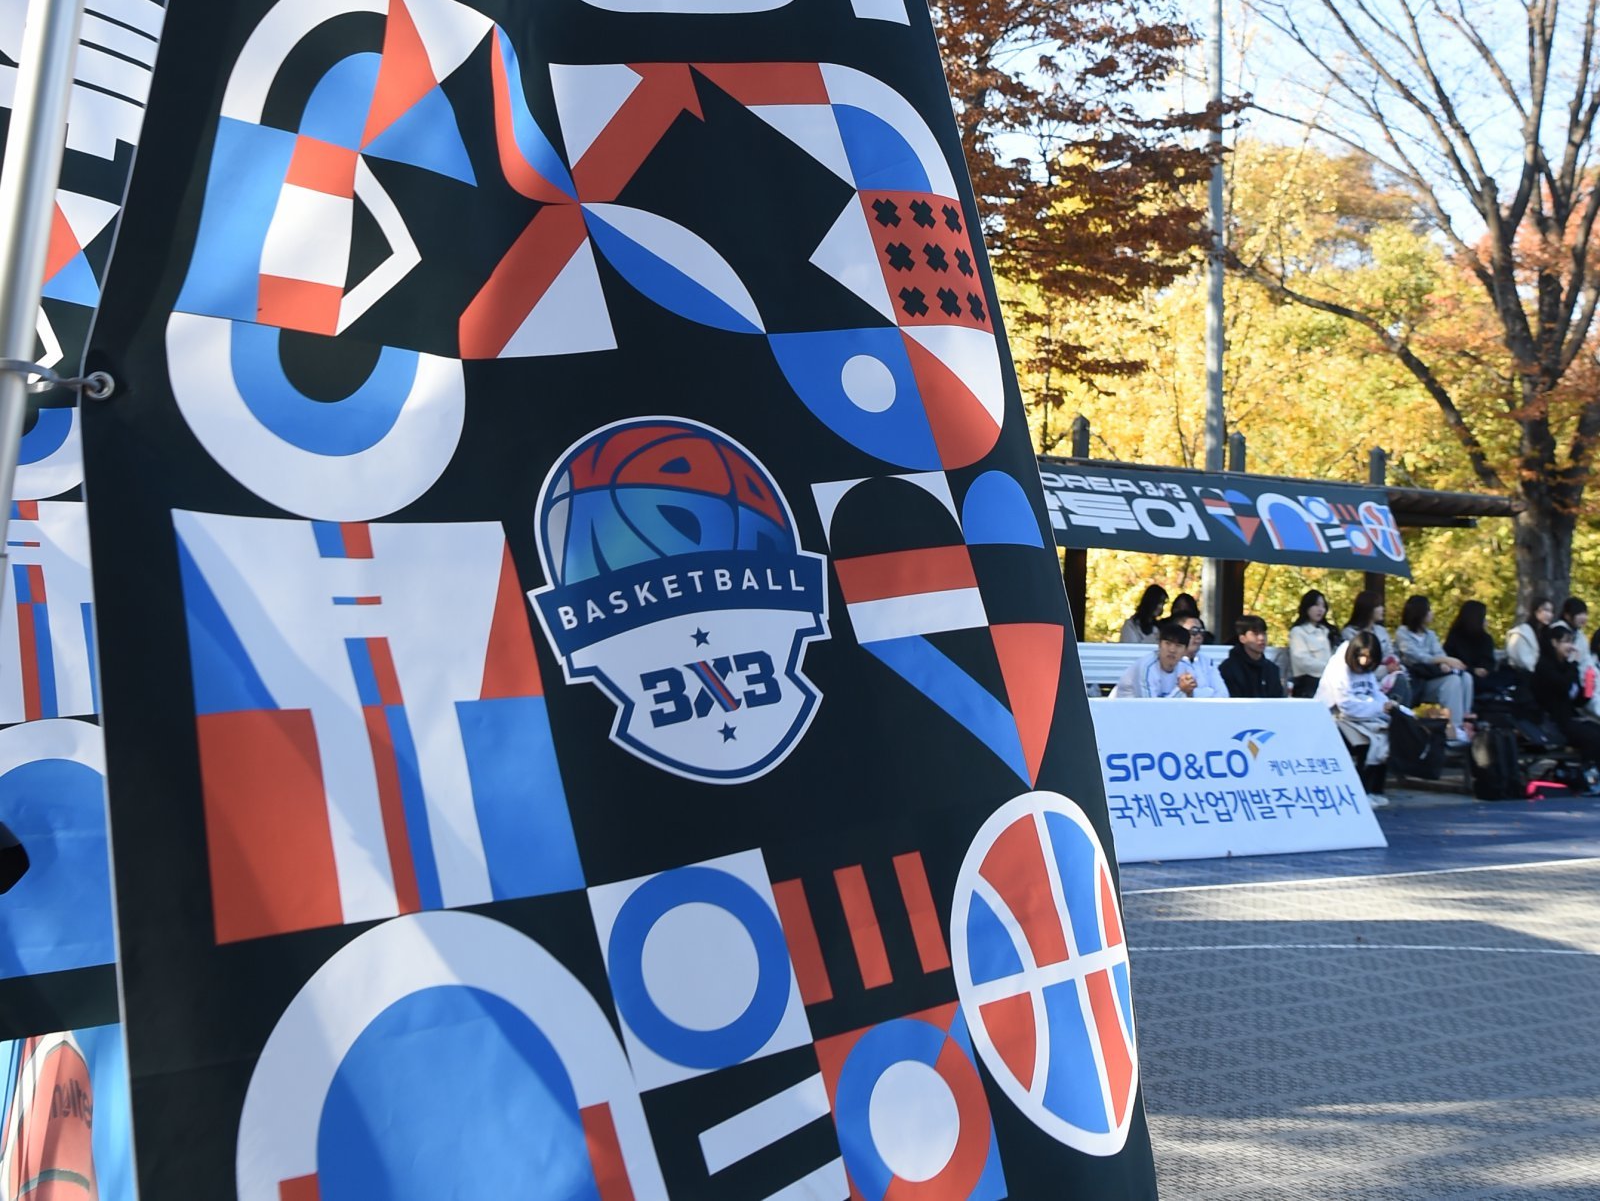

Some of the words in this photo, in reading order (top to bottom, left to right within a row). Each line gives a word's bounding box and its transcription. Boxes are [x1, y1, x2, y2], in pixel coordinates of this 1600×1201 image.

[1040, 471, 1143, 496] OREA
[1044, 488, 1211, 542] 투어
[557, 568, 806, 630] BASKETBALL
[640, 650, 783, 729] 3X3
[1105, 749, 1249, 782] SPO&CO
[1109, 783, 1361, 829] 국체육산업개발주식회사
